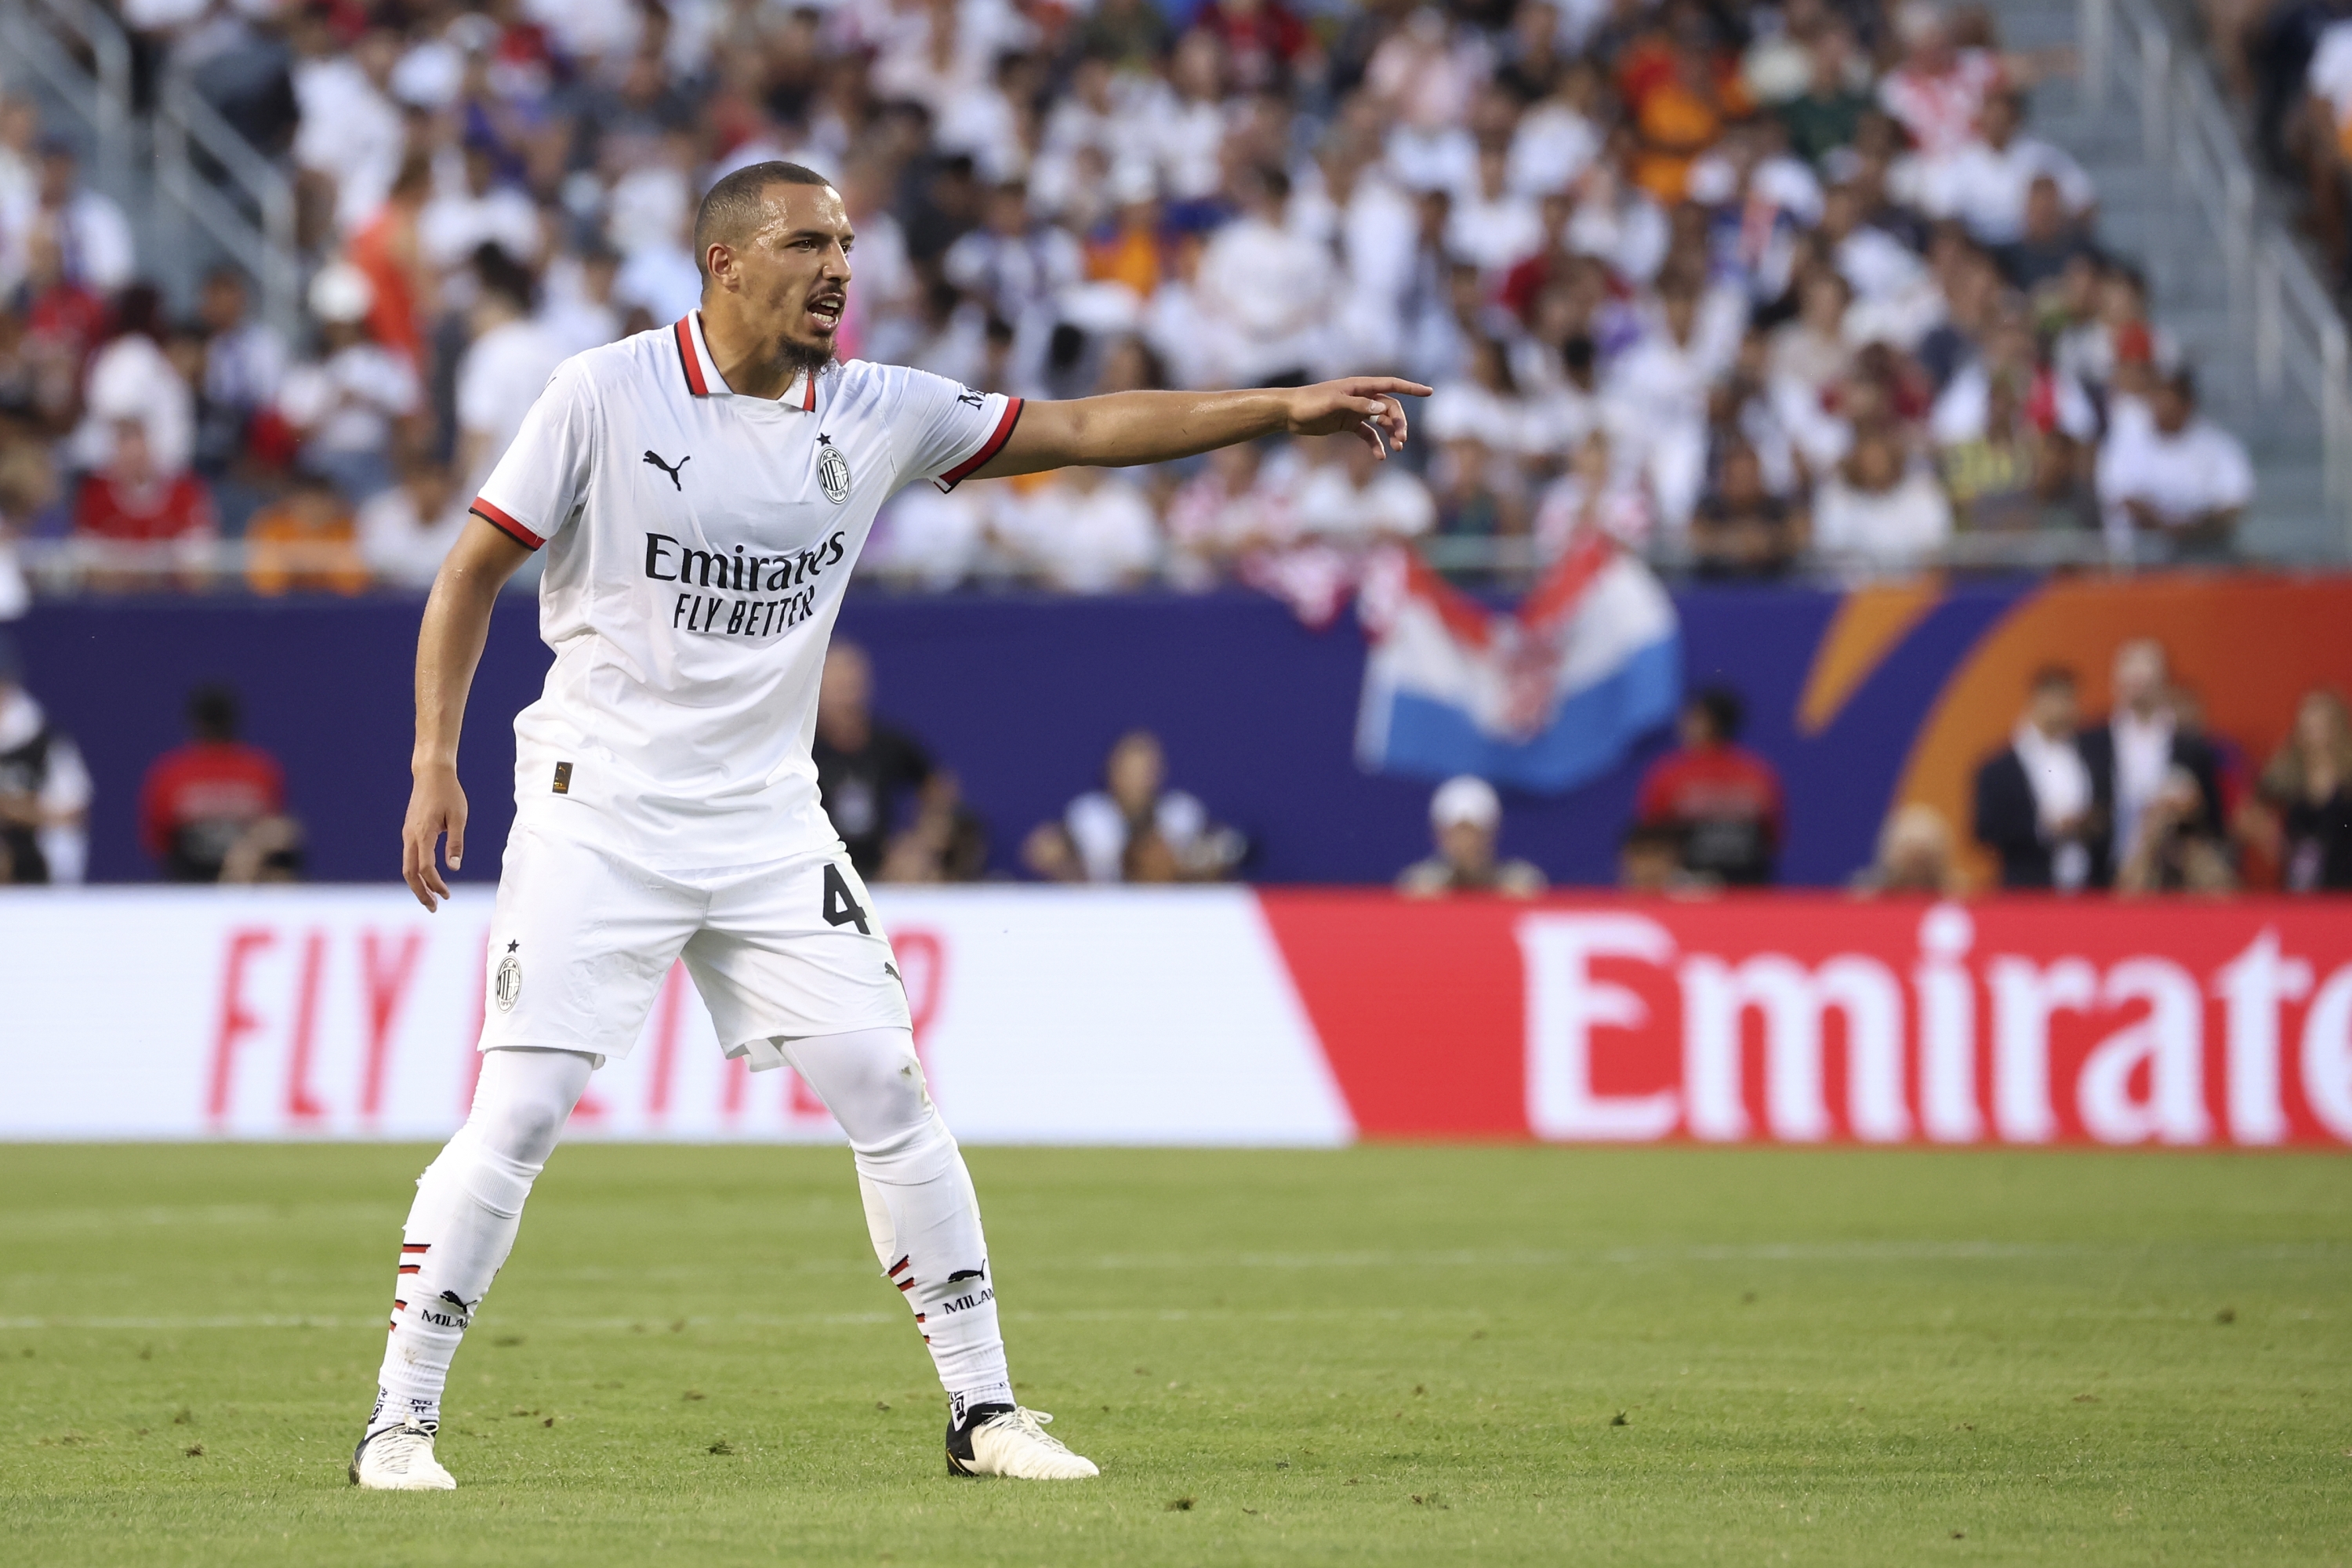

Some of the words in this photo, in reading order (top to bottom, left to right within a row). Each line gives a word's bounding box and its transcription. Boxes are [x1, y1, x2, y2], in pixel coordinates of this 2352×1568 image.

[822, 451, 840, 464] ACM
[831, 488, 847, 498] 1899
[645, 531, 845, 592] Emirates
[673, 593, 724, 633] FLY
[726, 584, 815, 637] BETTER
[822, 863, 871, 935] 4
[204, 924, 427, 1120] FLY
